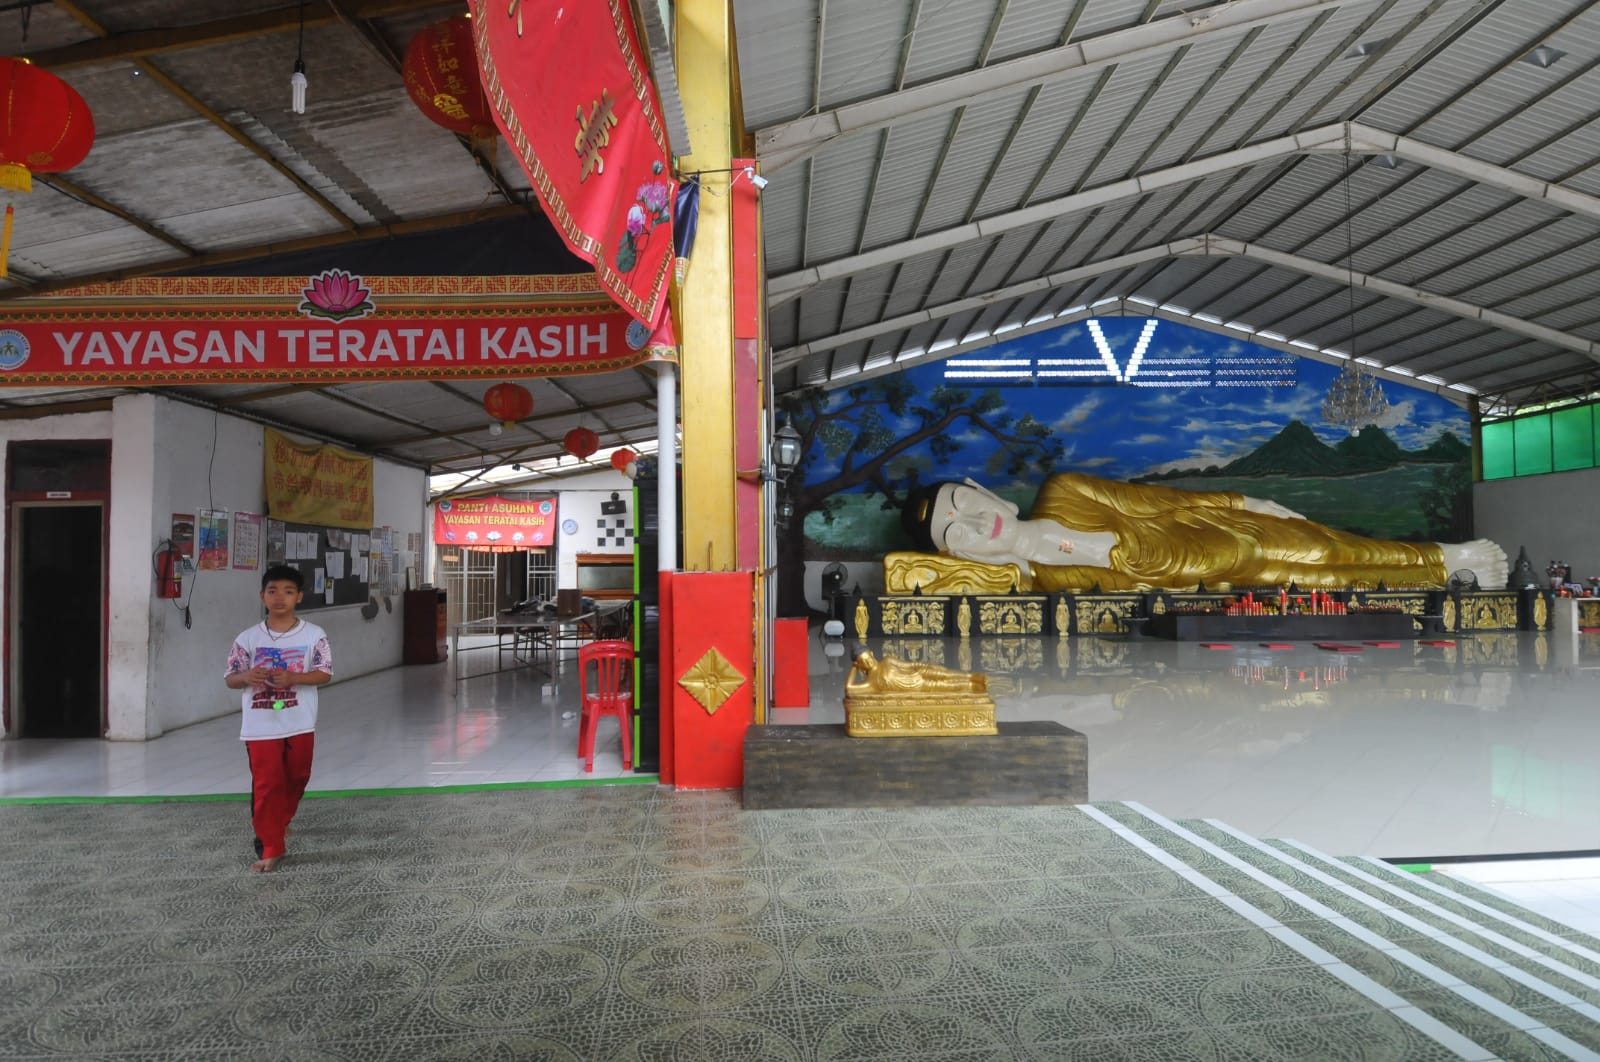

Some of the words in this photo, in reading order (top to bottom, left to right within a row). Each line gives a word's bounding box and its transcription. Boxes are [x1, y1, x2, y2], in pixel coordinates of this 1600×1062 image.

[52, 329, 265, 366] YAYASAN
[278, 328, 464, 363] TERATAI
[480, 322, 608, 359] KASIH
[457, 503, 489, 513] PANTI
[491, 503, 535, 514] ASUHAN
[443, 514, 481, 525] YAYASAN
[483, 515, 517, 526] TERATAI
[519, 516, 545, 526] KASIH
